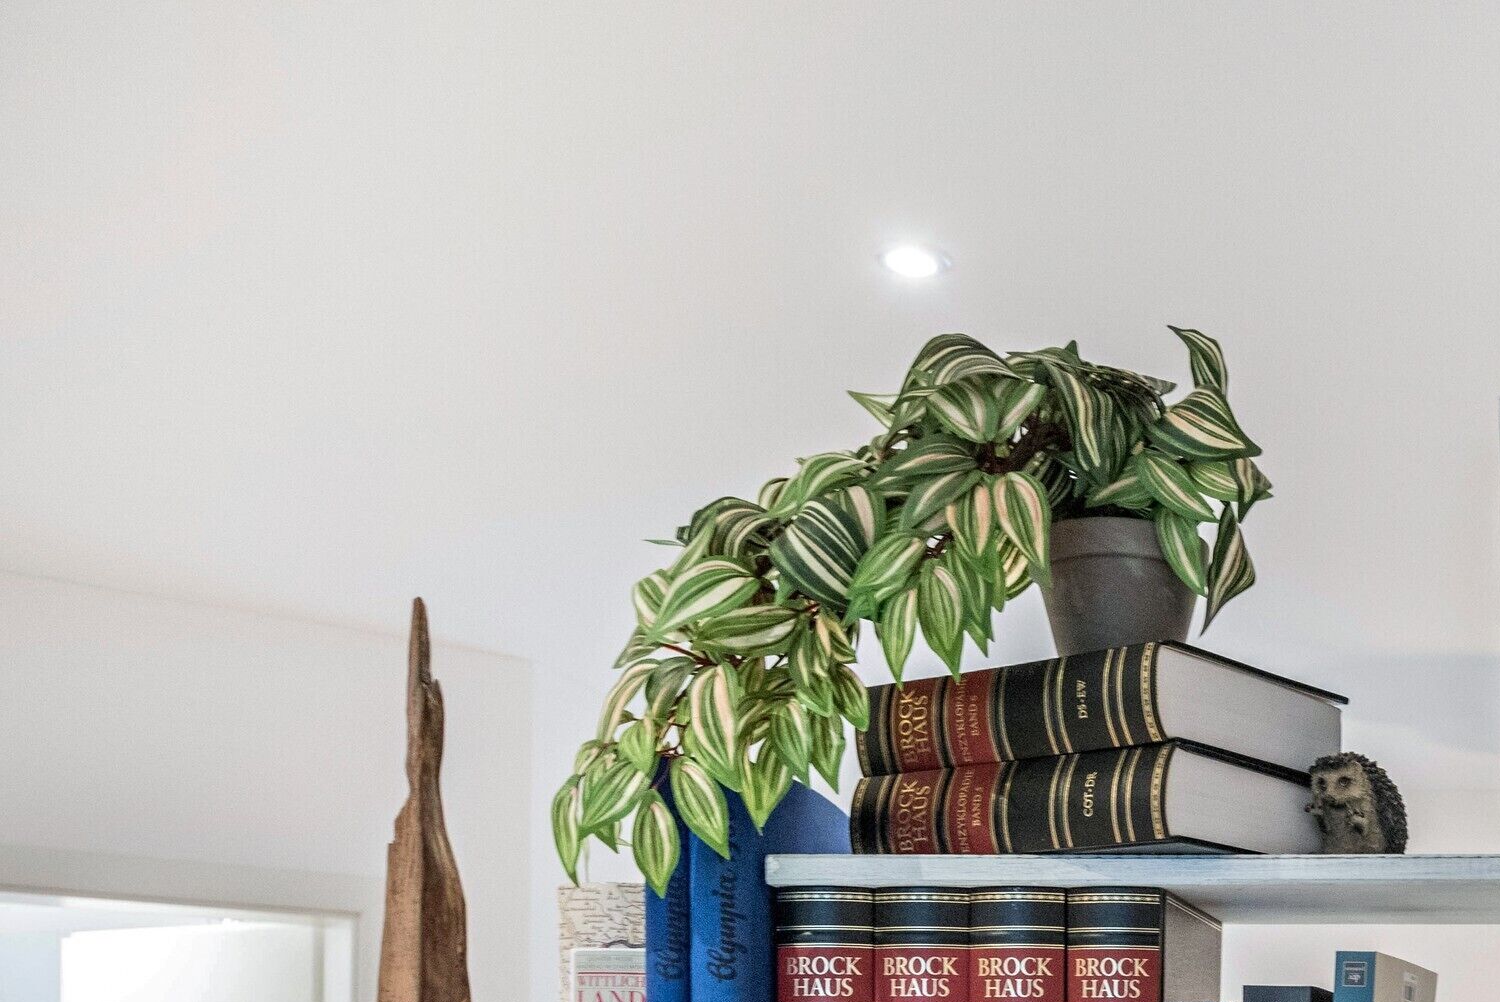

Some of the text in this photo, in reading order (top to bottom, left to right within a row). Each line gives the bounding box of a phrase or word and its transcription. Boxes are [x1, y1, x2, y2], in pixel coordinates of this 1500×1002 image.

[914, 784, 931, 843] HAUS
[884, 957, 958, 976] BROCK
[890, 977, 949, 997] HAUS
